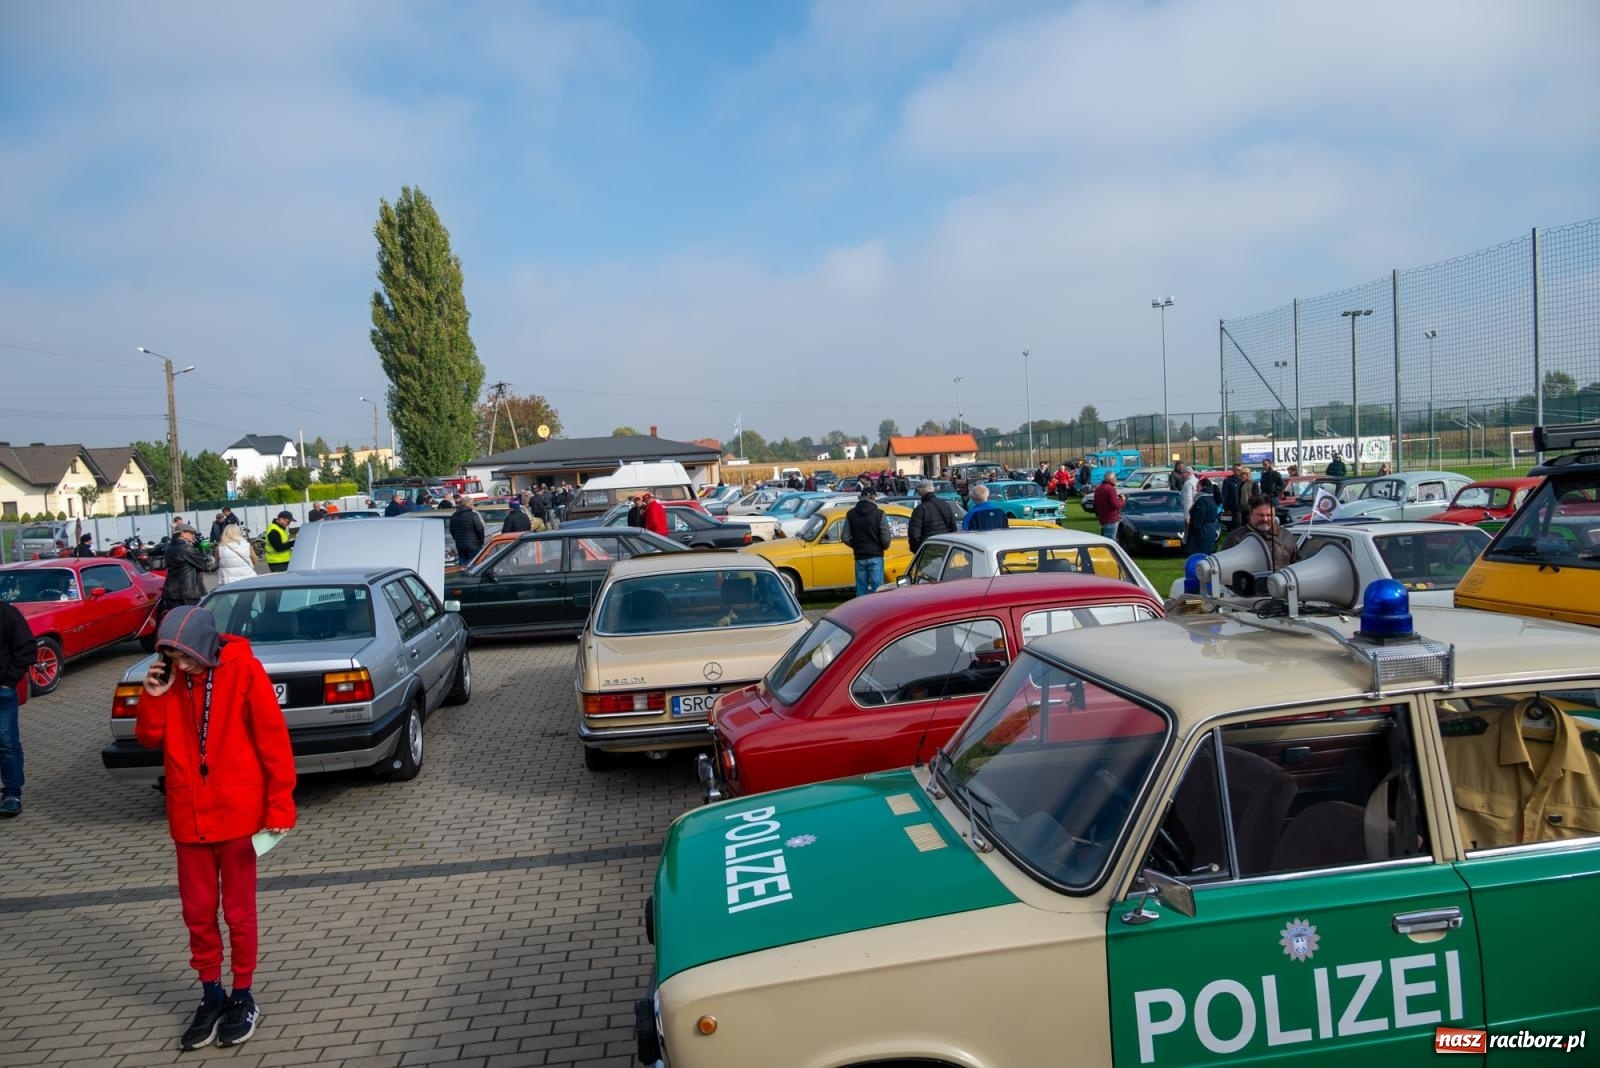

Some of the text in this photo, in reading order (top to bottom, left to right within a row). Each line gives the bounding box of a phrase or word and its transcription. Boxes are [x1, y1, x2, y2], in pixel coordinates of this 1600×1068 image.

[1277, 447, 1298, 463] LKS
[725, 806, 793, 914] POLIZEI
[1134, 950, 1464, 1064] POLIZEI
